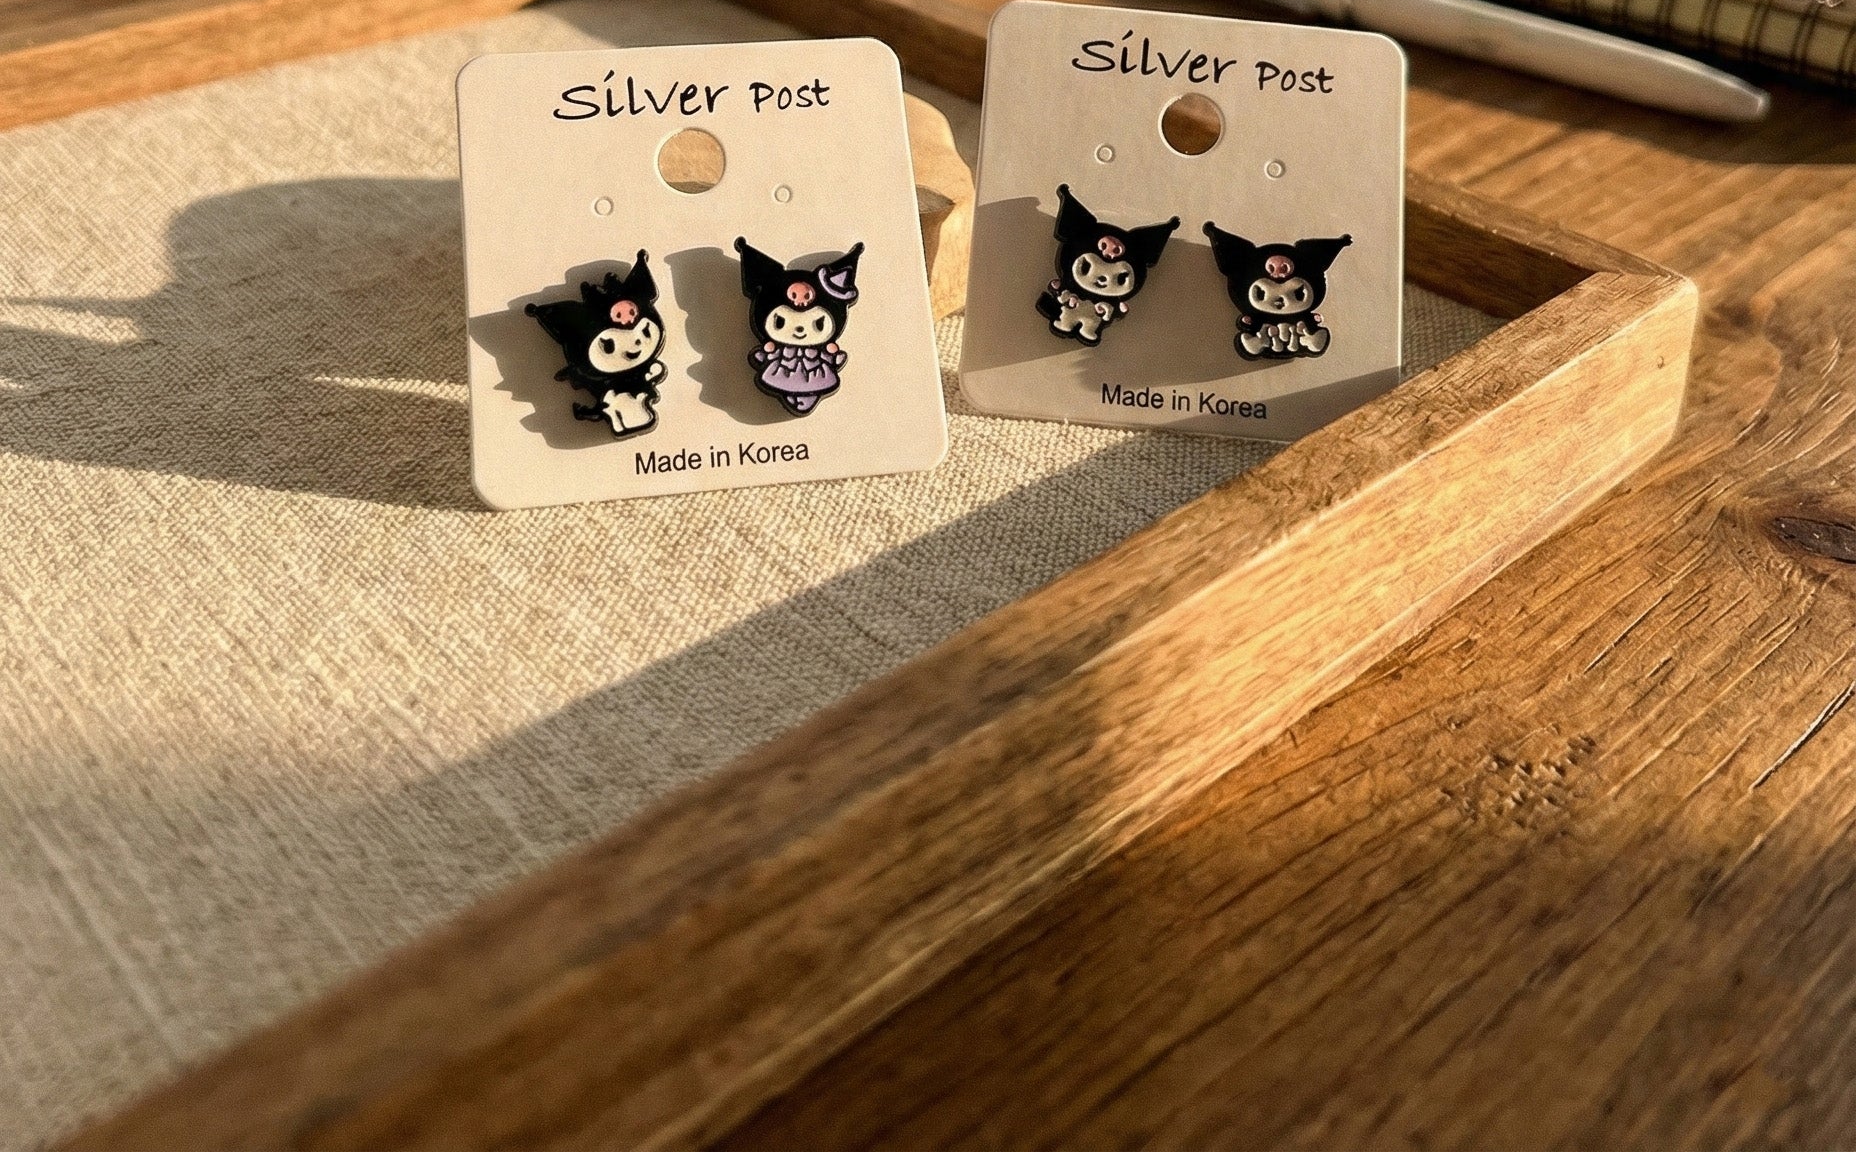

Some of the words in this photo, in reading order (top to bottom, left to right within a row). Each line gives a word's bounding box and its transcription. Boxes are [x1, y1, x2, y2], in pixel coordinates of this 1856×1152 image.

[1071, 29, 1237, 84] Silver
[1254, 61, 1334, 94] Post
[552, 69, 730, 121] Silver
[748, 78, 830, 113] Post
[1102, 382, 1165, 410] Made
[1171, 389, 1192, 412] in
[1199, 391, 1268, 420] Korea
[635, 448, 702, 475] Made
[709, 445, 732, 468] in
[738, 442, 810, 467] Korea
